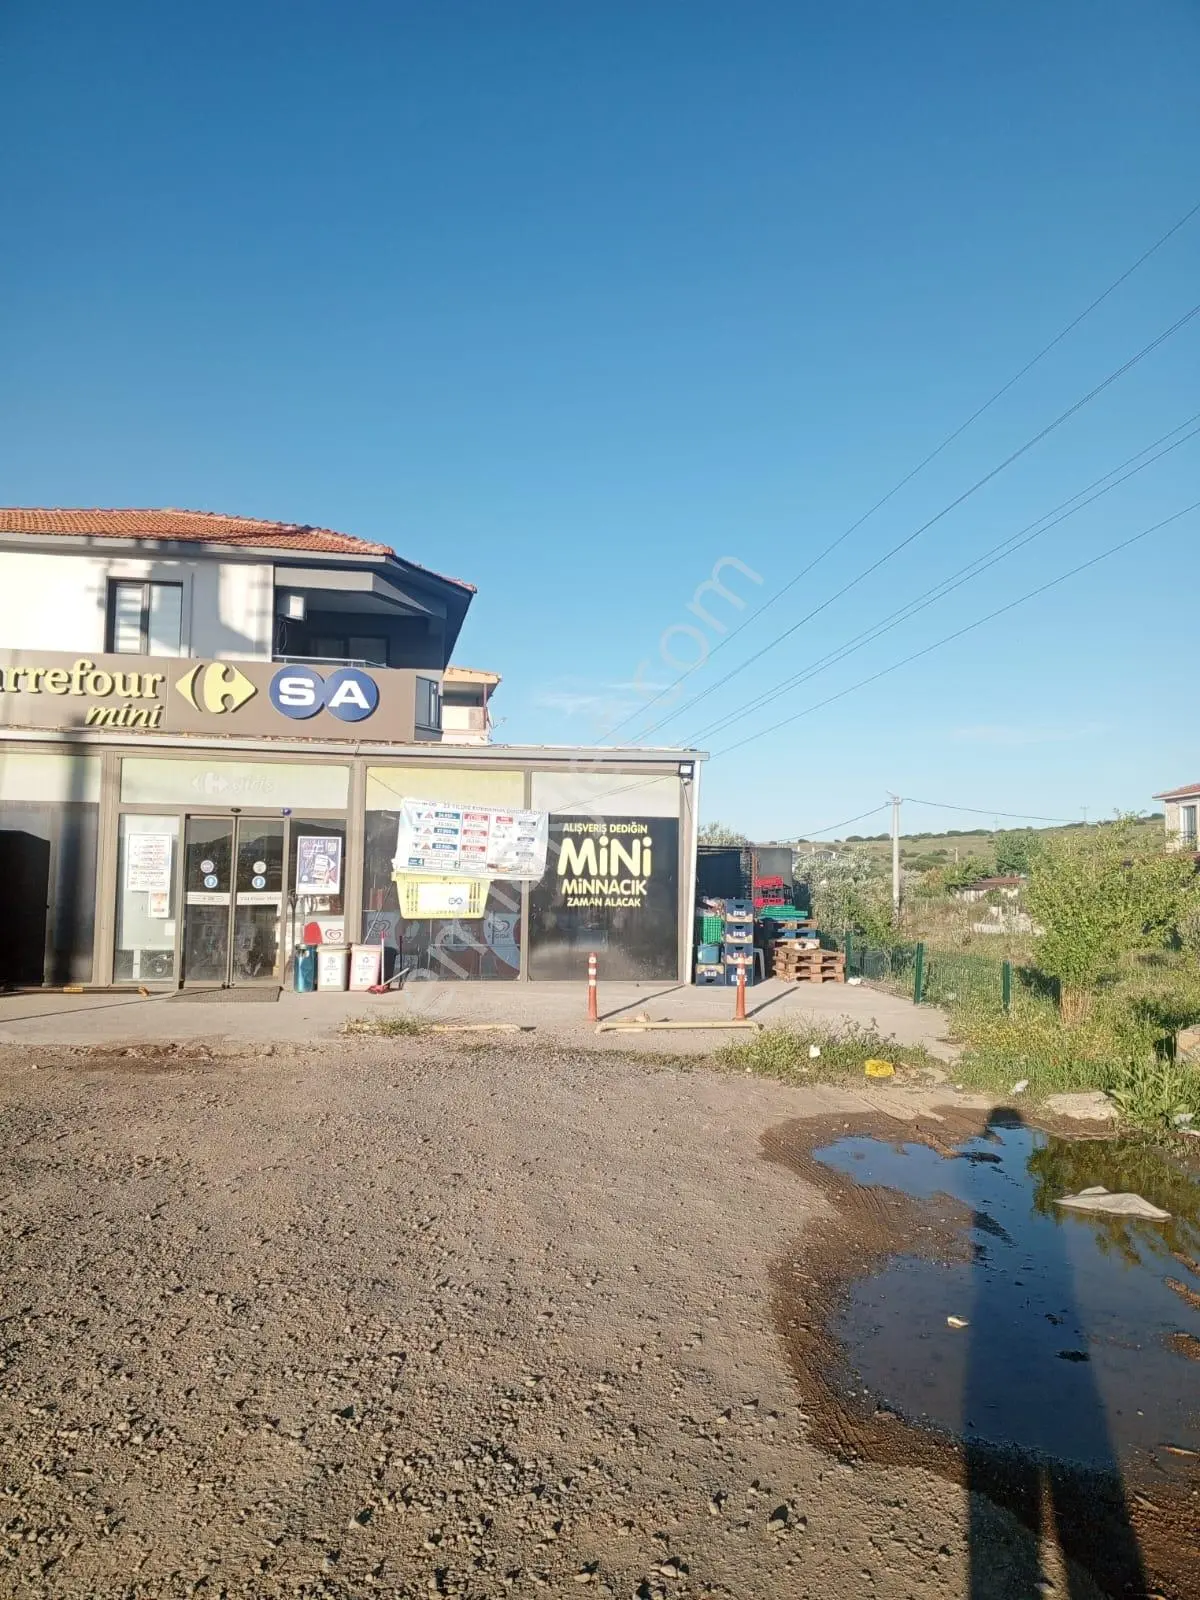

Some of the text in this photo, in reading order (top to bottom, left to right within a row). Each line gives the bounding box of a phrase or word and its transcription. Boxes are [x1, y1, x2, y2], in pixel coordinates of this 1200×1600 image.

[0, 659, 165, 699] rrefour
[278, 676, 371, 709] SA
[84, 702, 164, 728] mini
[567, 897, 641, 907] ZAMAN ALACAK
